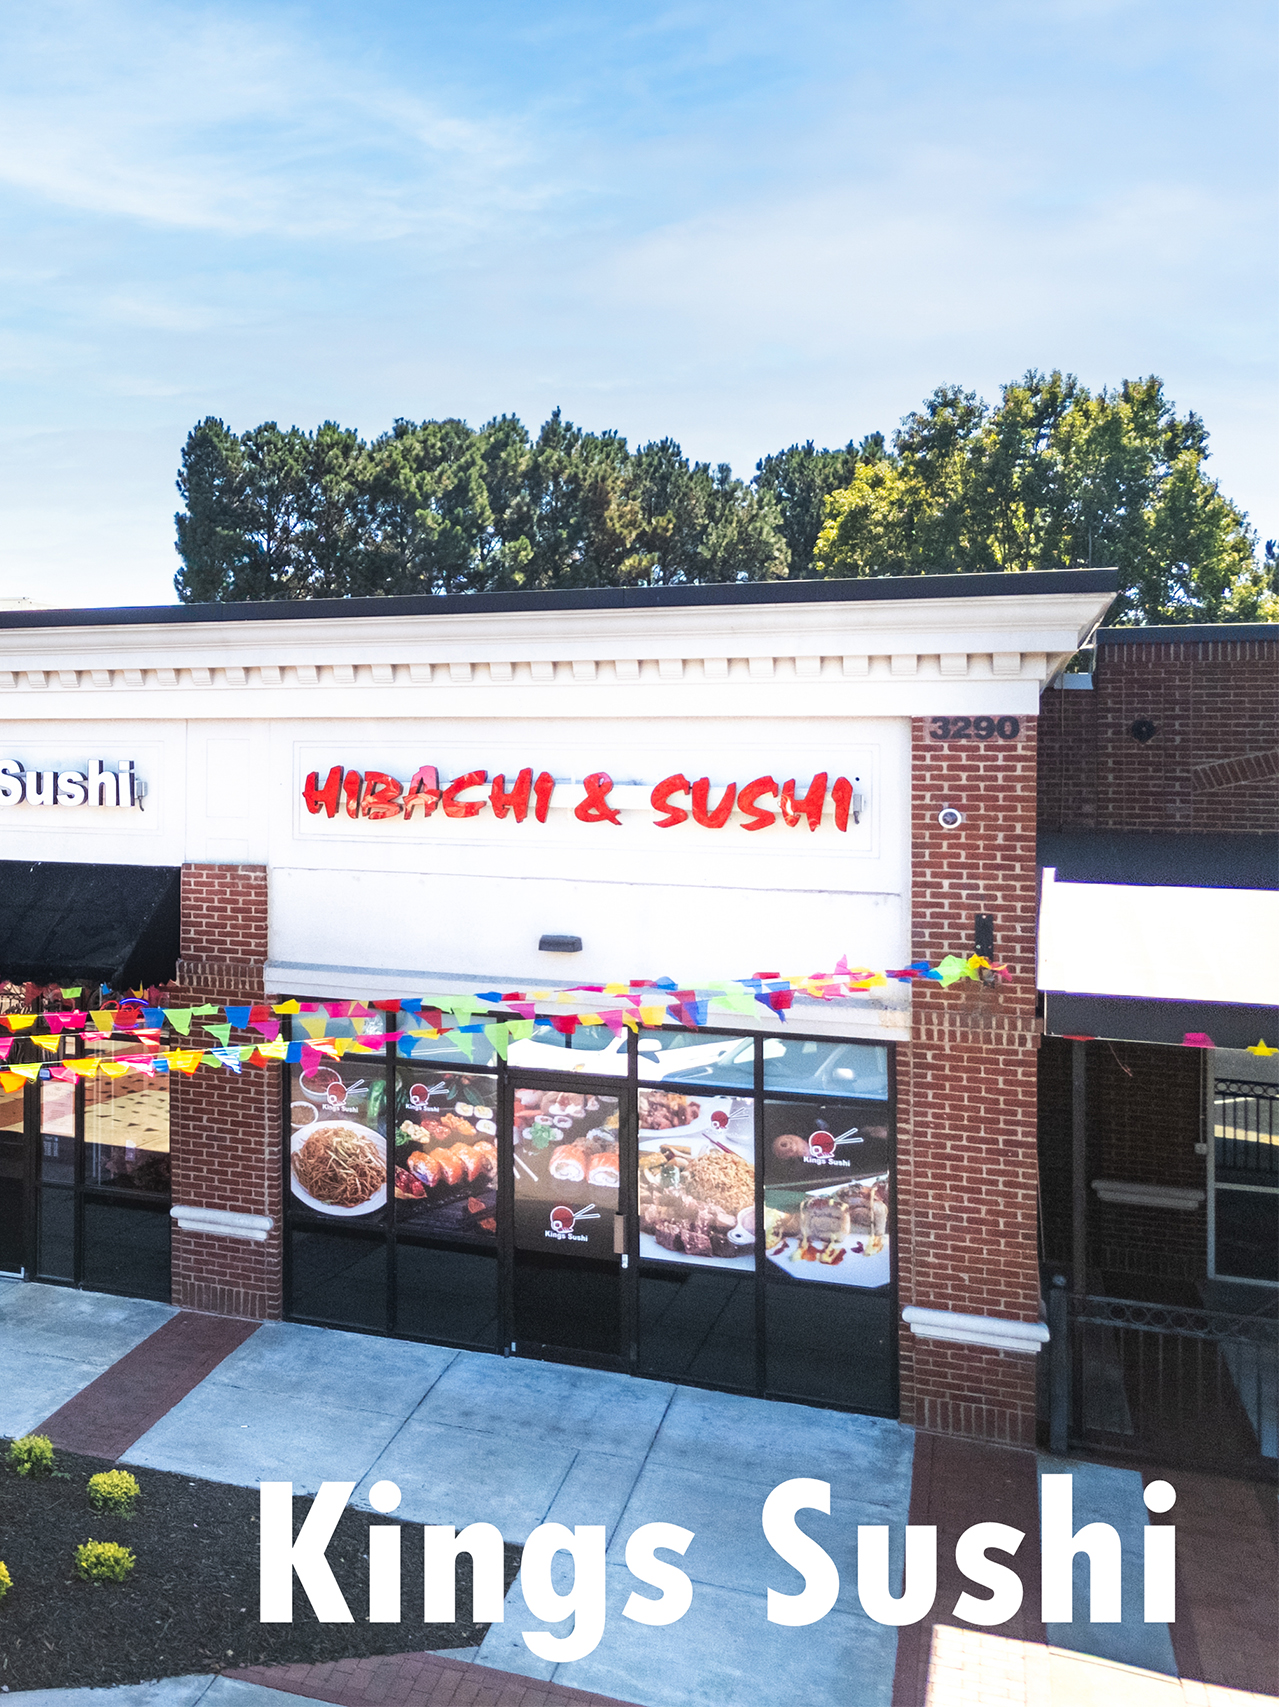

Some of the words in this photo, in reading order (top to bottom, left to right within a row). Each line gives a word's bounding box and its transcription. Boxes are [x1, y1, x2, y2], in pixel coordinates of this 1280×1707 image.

[929, 715, 1020, 740] 3290
[302, 765, 556, 824] HIBACHI
[574, 771, 622, 826] &
[650, 771, 854, 832] SUSHI
[803, 1156, 826, 1165] Kings
[828, 1158, 851, 1167] Sushi
[544, 1230, 566, 1240] Kings
[567, 1233, 588, 1242] Sushi
